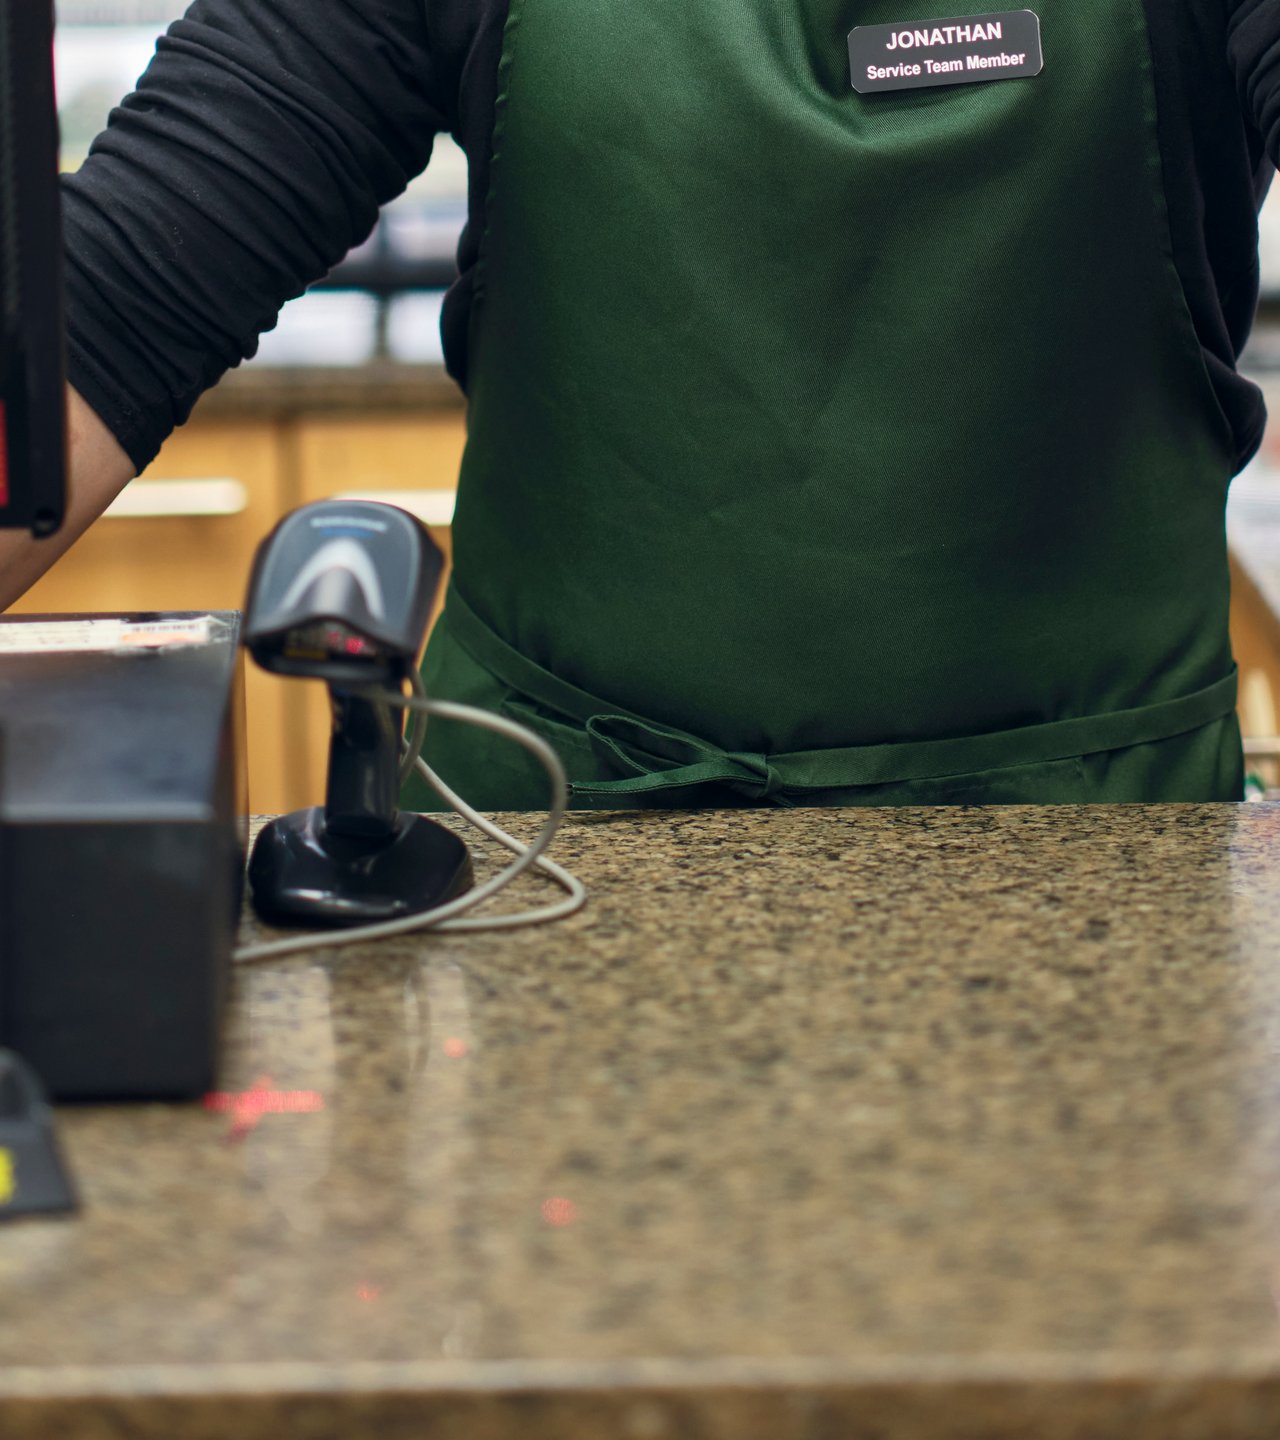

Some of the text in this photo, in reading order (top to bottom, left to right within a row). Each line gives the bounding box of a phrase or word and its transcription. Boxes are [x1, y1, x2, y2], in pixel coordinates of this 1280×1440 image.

[886, 22, 1003, 50] JONATHAN
[867, 51, 1026, 80] Service Team Member
